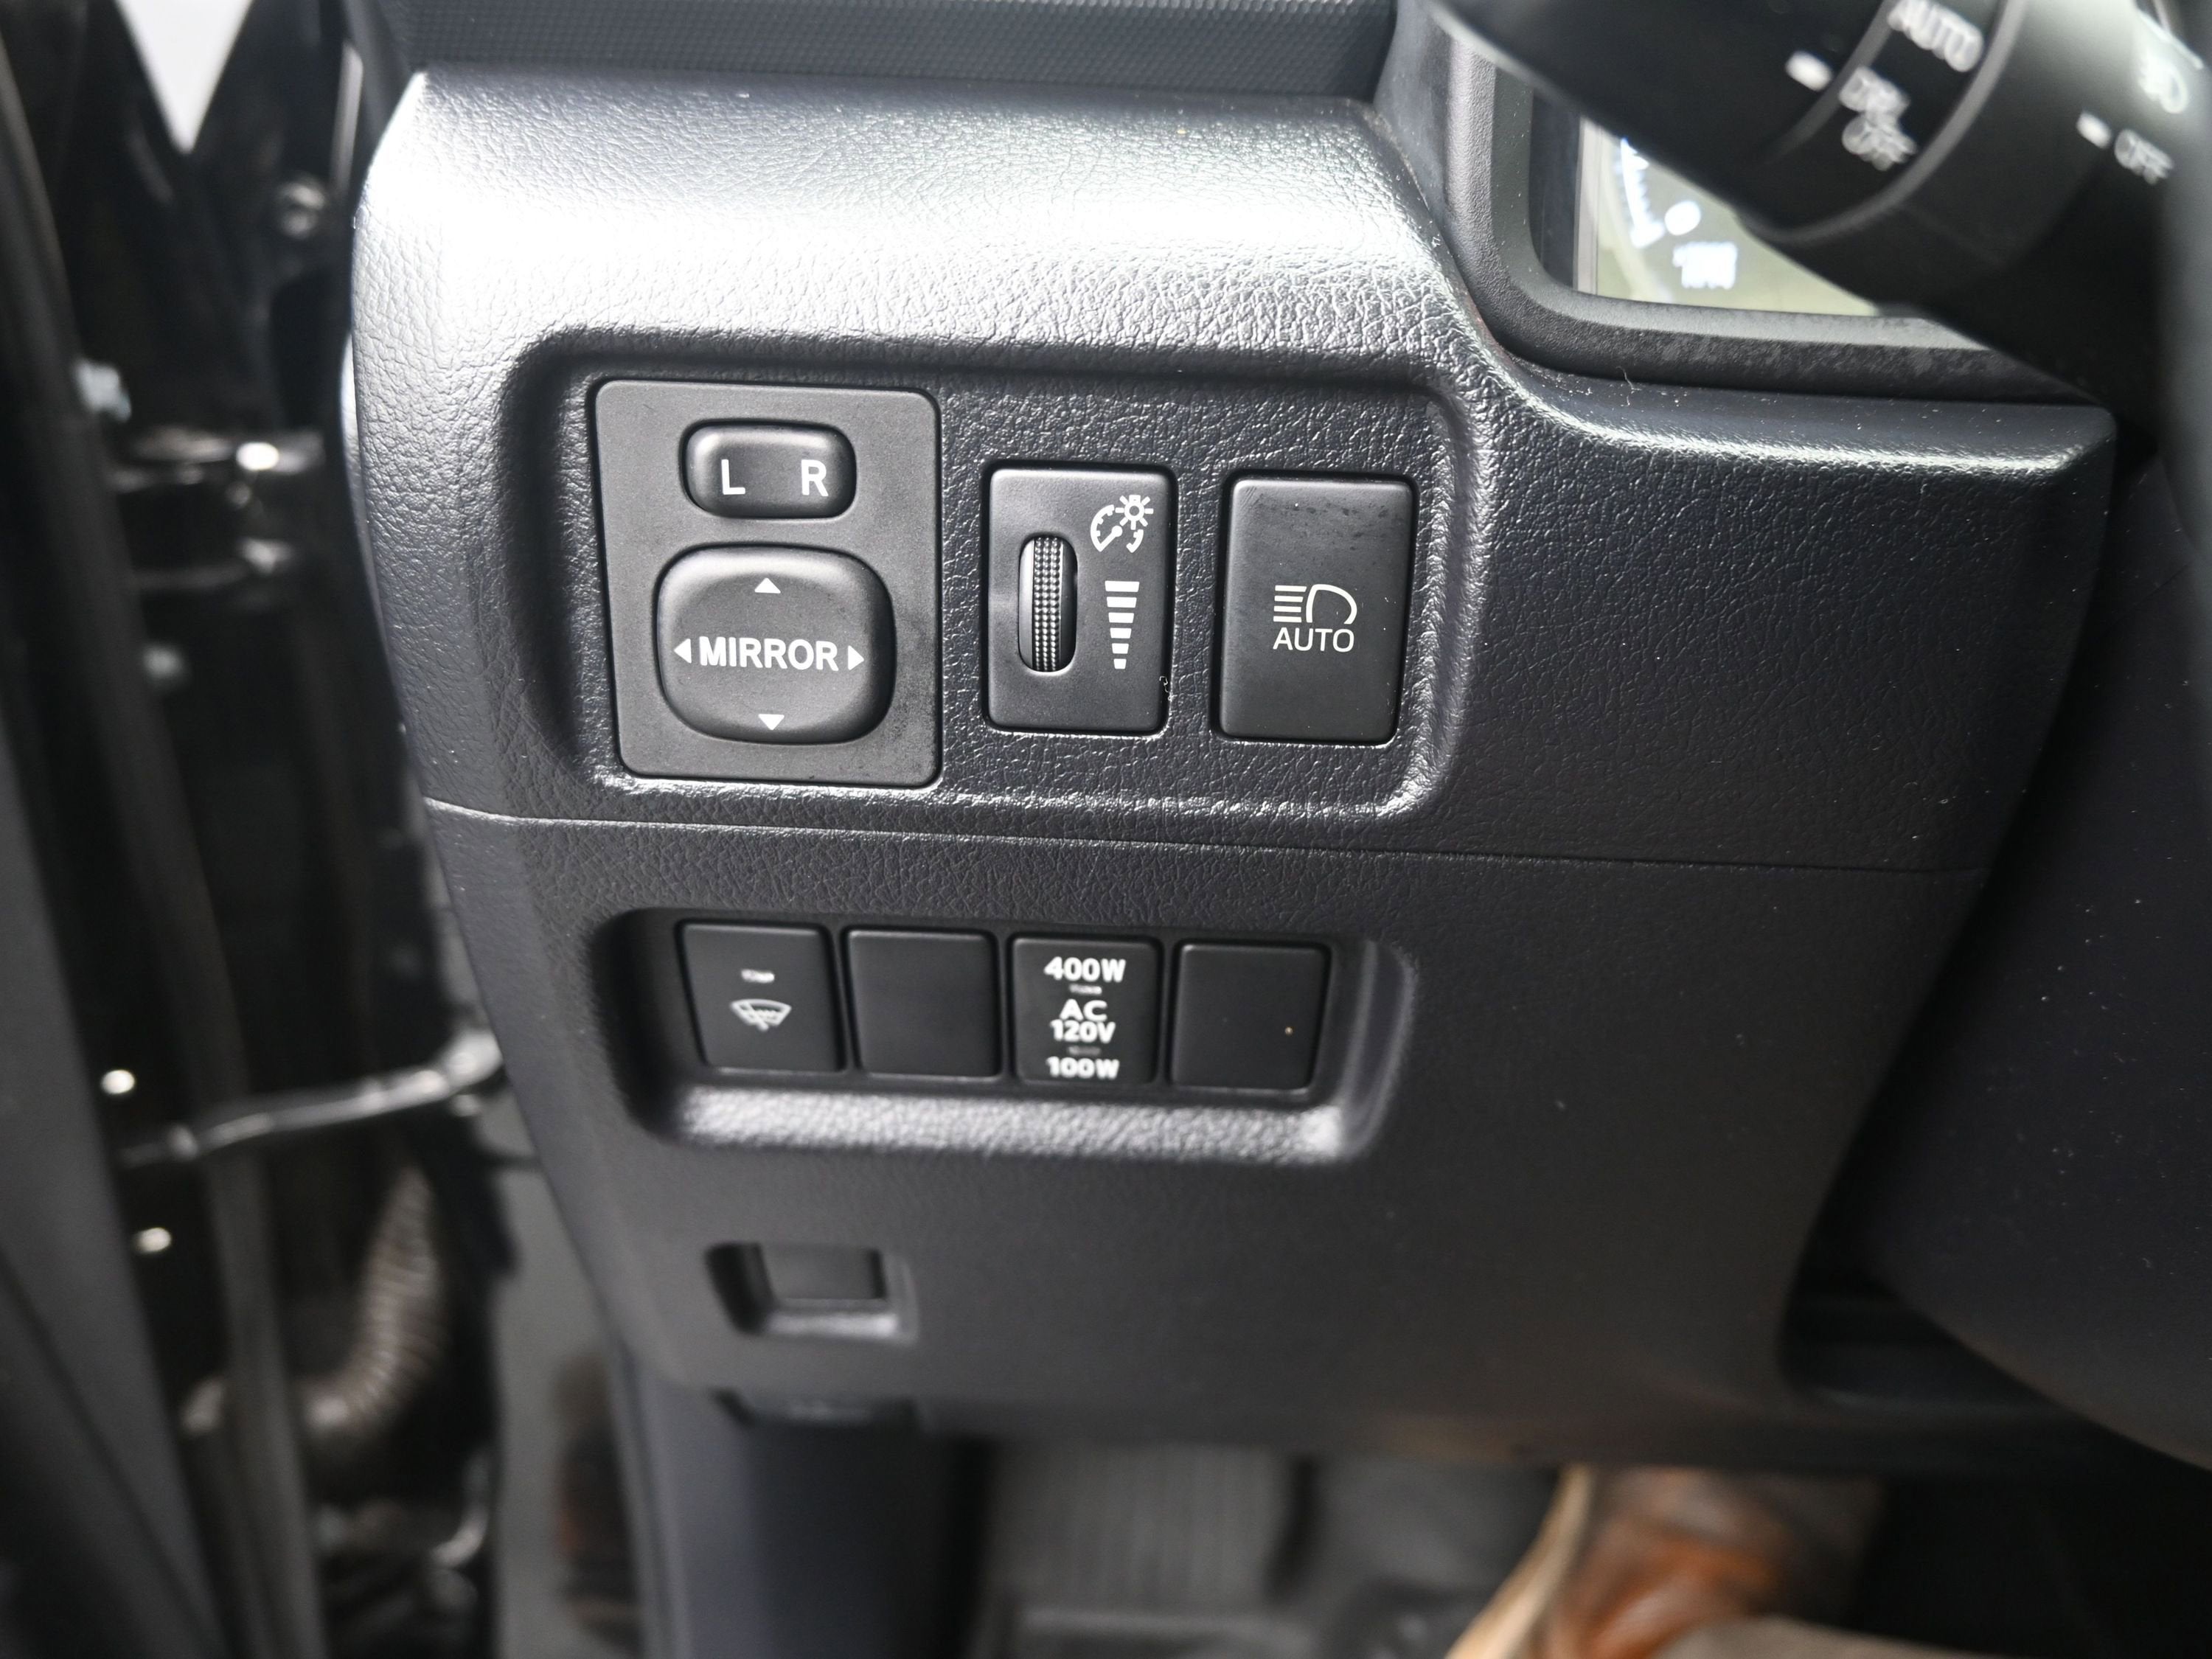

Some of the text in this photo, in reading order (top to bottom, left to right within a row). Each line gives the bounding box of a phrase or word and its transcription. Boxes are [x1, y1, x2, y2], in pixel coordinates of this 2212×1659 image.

[1886, 0, 1984, 72] AUTO
[720, 451, 829, 497] L R
[1273, 627, 1355, 653] AUTO
[698, 636, 839, 672] MIRROR
[1043, 956, 1126, 982] 400W
[1059, 998, 1107, 1021] AC
[1050, 1019, 1116, 1043] 120V
[1046, 1056, 1119, 1079] 100W
